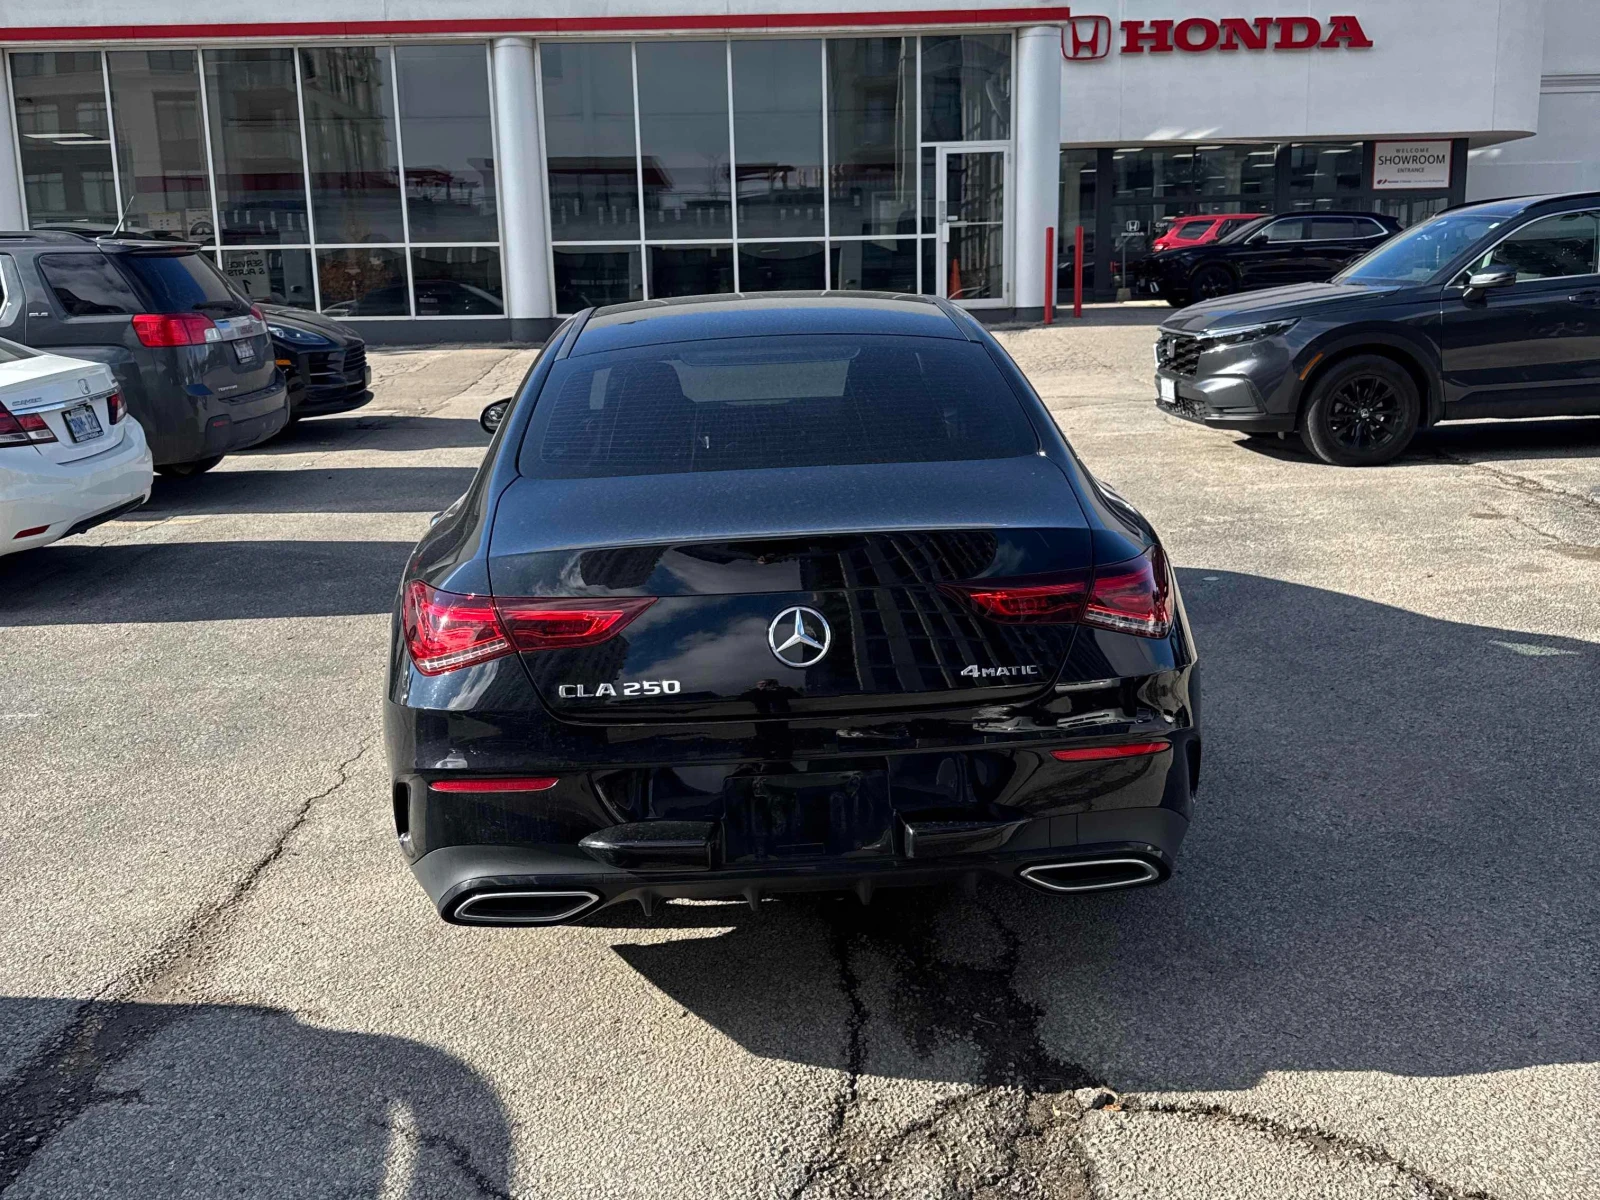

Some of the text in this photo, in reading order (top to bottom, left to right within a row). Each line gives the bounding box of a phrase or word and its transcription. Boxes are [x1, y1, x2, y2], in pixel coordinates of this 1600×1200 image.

[1120, 15, 1374, 53] HONDA
[1378, 154, 1446, 166] SHOWROOM
[960, 664, 1038, 678] 4MATIC
[558, 680, 681, 698] CLA 250
